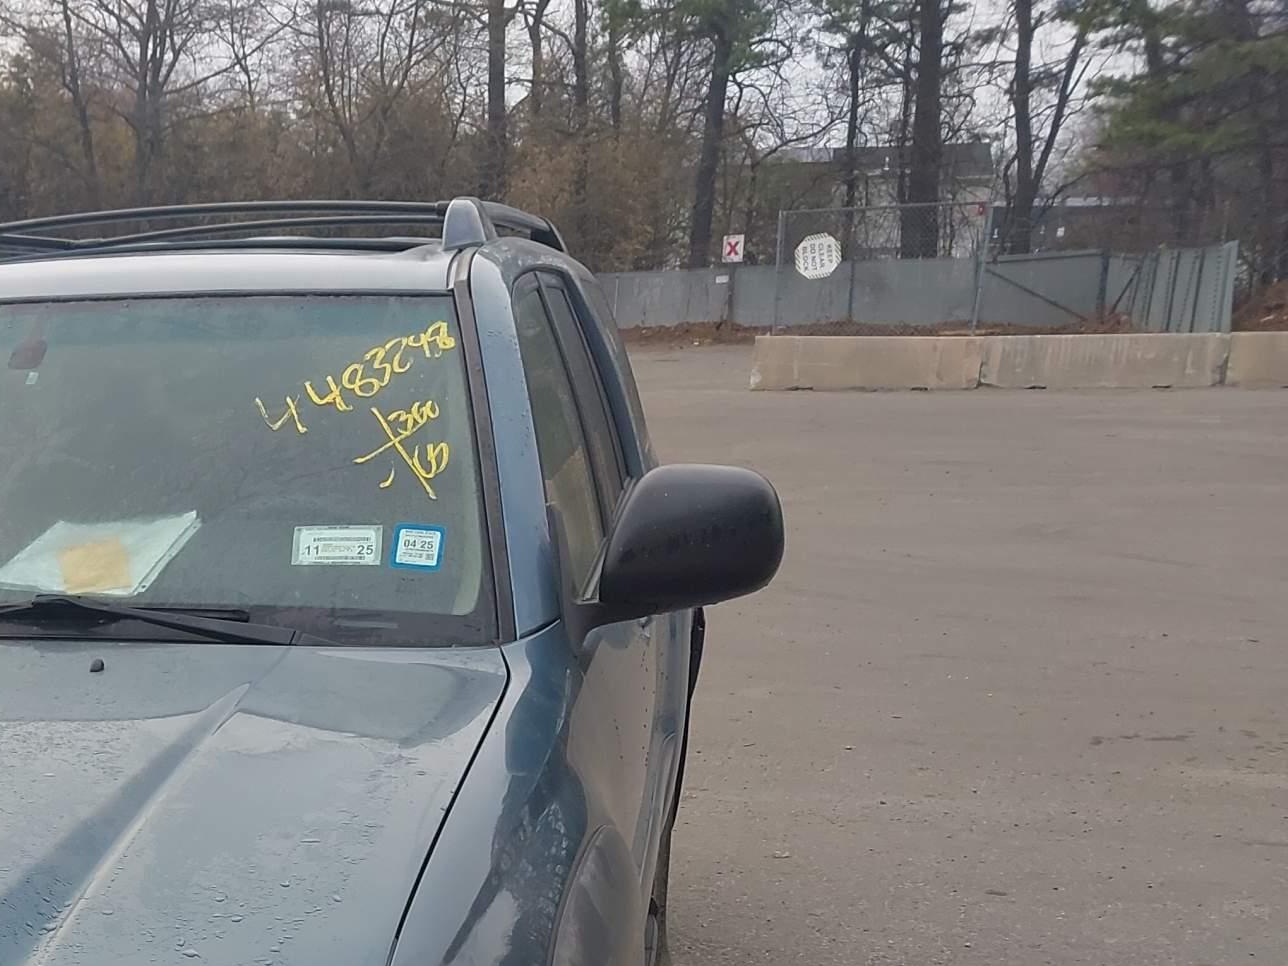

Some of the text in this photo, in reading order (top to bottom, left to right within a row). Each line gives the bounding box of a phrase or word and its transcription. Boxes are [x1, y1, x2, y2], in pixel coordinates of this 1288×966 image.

[304, 544, 321, 556] 11
[357, 544, 374, 556] 25
[403, 539, 434, 550] 04 25
